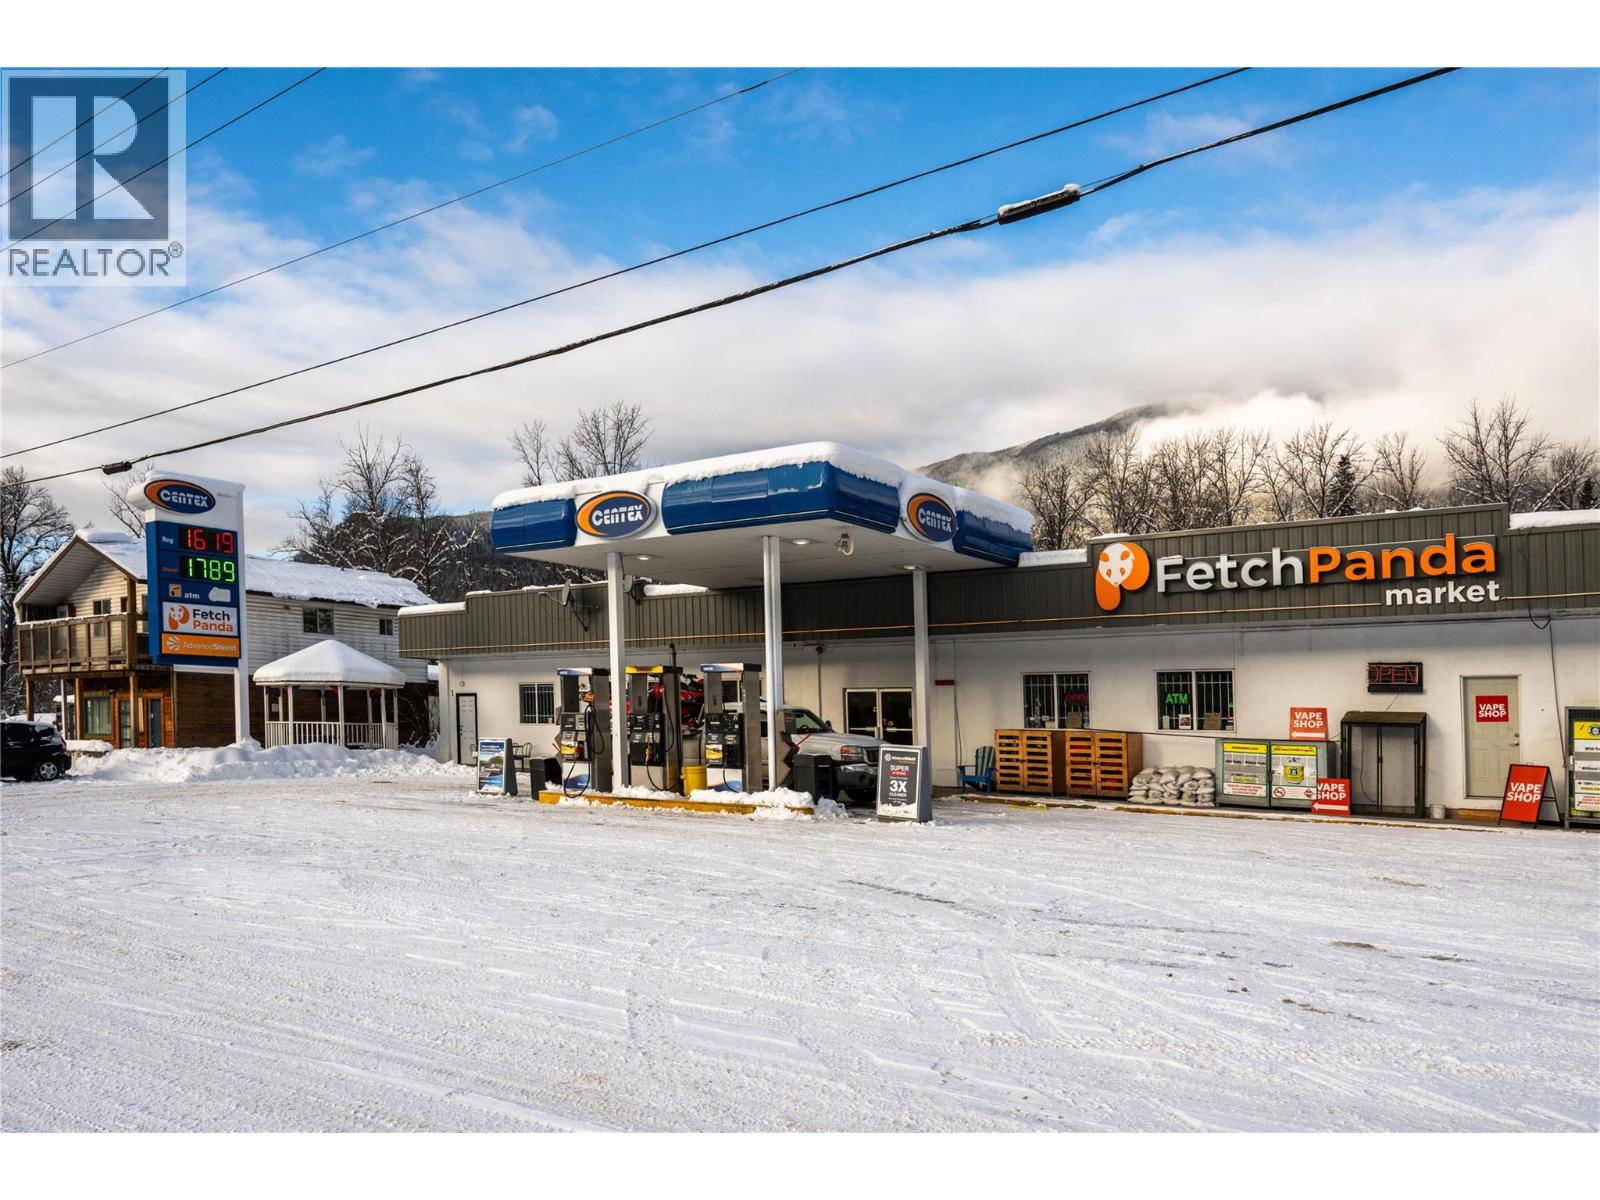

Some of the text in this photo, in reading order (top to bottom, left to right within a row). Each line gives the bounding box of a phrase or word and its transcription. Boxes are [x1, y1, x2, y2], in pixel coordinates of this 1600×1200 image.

[162, 536, 174, 545] Reg
[188, 558, 235, 582] 1789
[184, 592, 200, 600] atm
[1385, 580, 1500, 606] market
[192, 608, 231, 621] Fetch
[192, 620, 234, 632] Panda
[1367, 665, 1418, 684] OPEN
[1165, 693, 1188, 704] ATM
[1479, 703, 1505, 711] VAPE
[1294, 711, 1323, 720] VAPE
[1478, 710, 1507, 718] SHOP
[1293, 720, 1324, 728] SHOP
[889, 780, 907, 792] 3X
[1510, 782, 1542, 793] VAPE
[1506, 791, 1541, 803] SHOP
